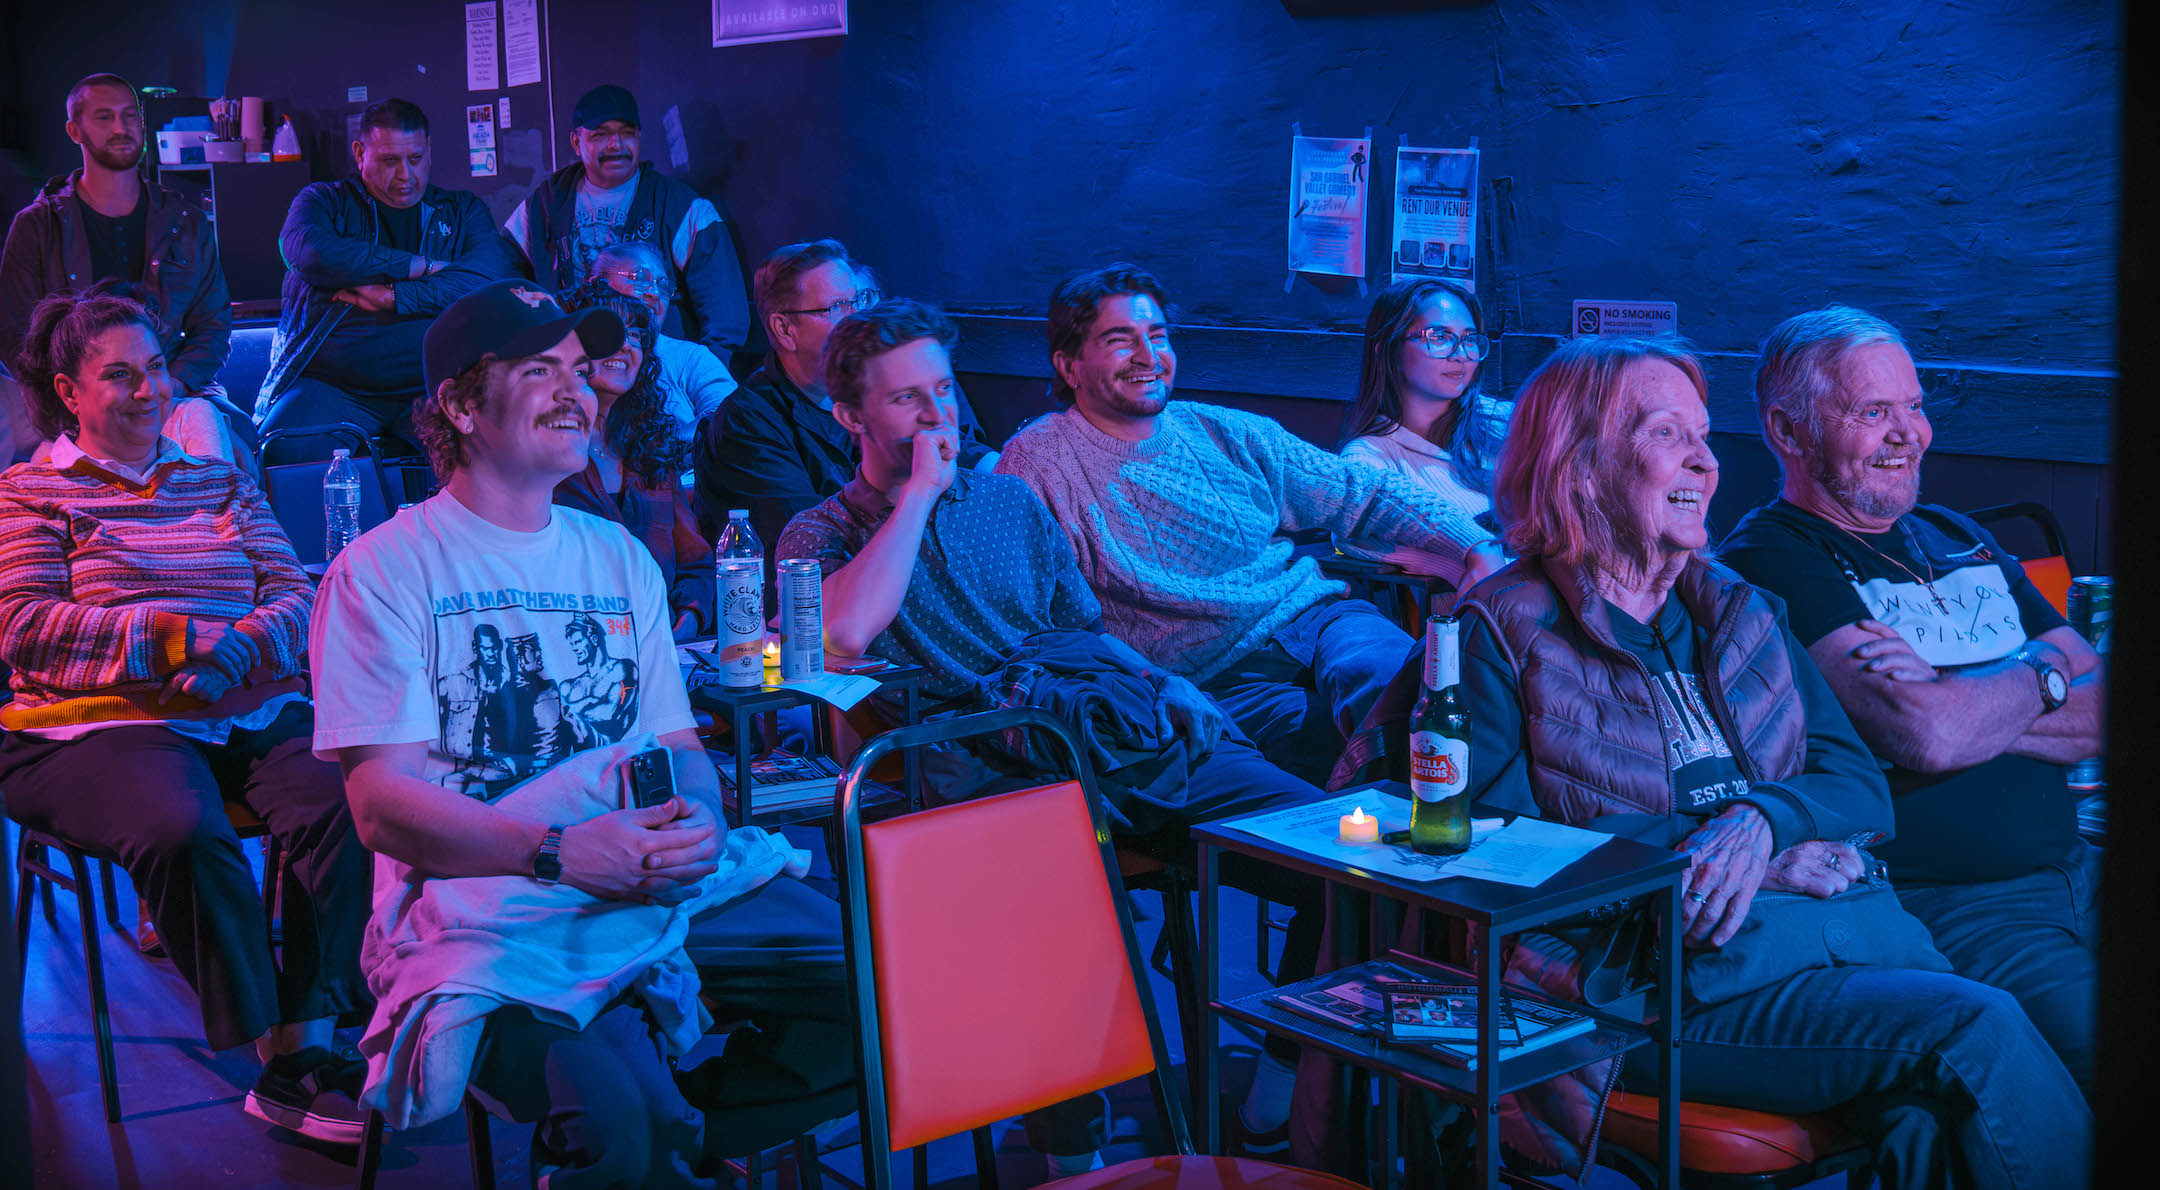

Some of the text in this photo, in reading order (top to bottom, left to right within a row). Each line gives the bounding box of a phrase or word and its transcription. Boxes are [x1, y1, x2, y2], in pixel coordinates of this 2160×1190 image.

[725, 4, 837, 25] AVAILABLE ON DVD
[1304, 182, 1357, 197] VALLEY COMEDY
[1401, 198, 1423, 214] RENT
[1424, 199, 1440, 215] OUR
[1604, 309, 1671, 320] NO SMOKING
[476, 588, 579, 609] MATTHEWS
[581, 594, 630, 612] BAND
[722, 589, 738, 617] WHITE
[729, 621, 747, 632] HARD
[1413, 757, 1448, 770] STELLA
[1413, 766, 1448, 778] ARTOIS
[1689, 782, 1732, 806] EST.
